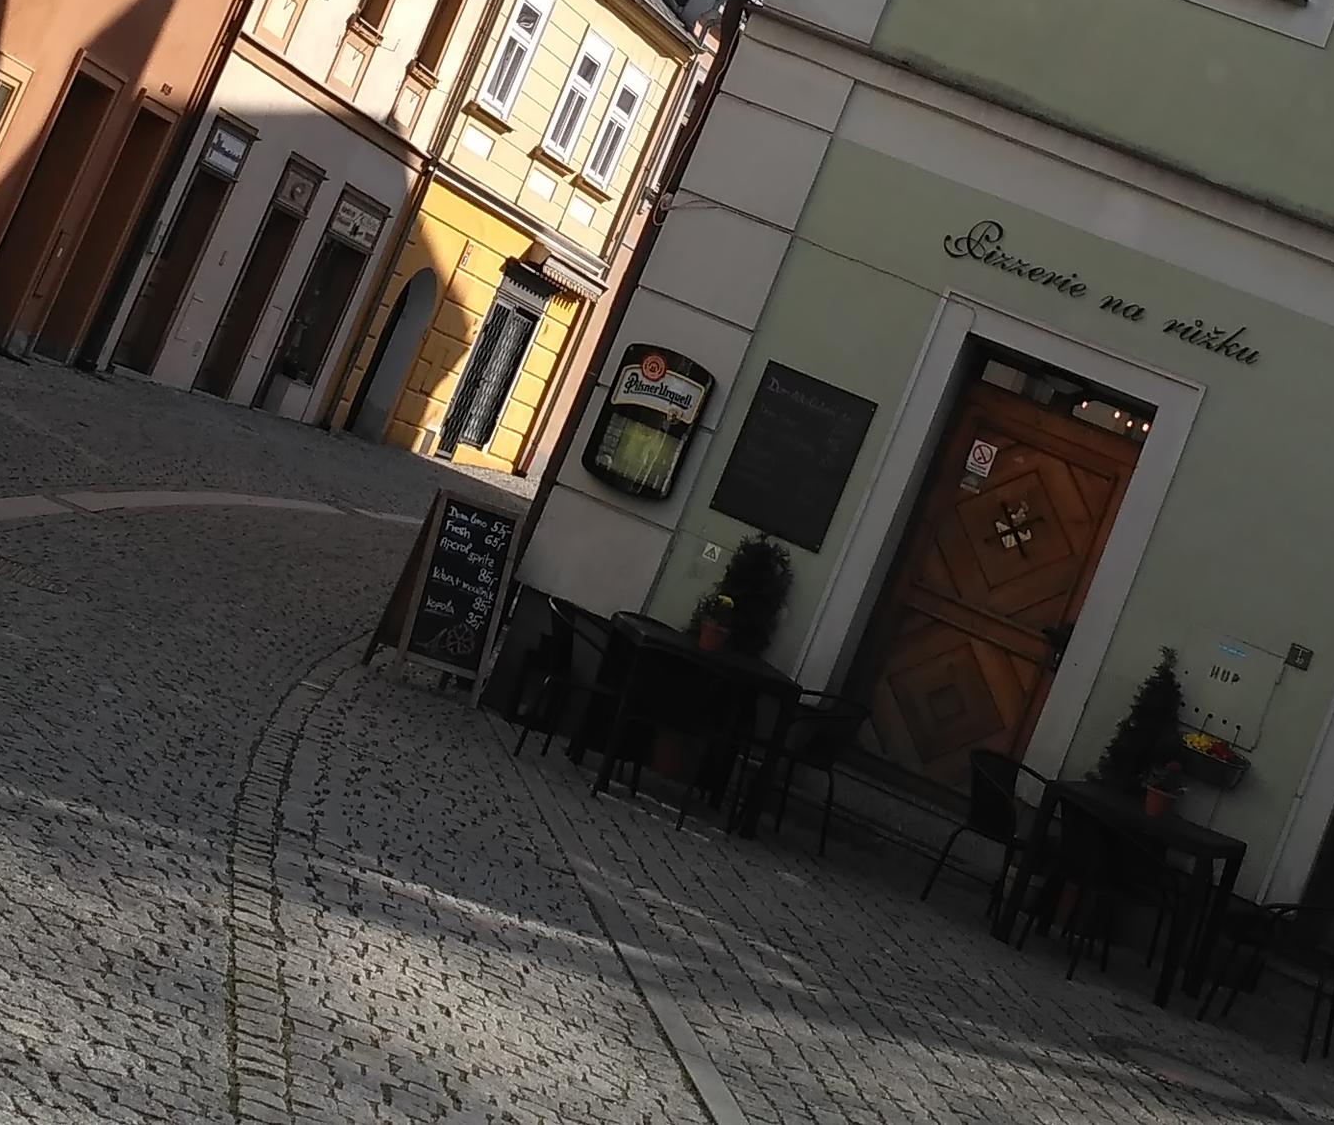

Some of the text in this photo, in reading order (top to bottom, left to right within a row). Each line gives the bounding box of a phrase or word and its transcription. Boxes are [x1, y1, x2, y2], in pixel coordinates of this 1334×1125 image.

[944, 220, 1261, 366] Pizzerie na růžku
[623, 372, 693, 406] Pilsner Urquell
